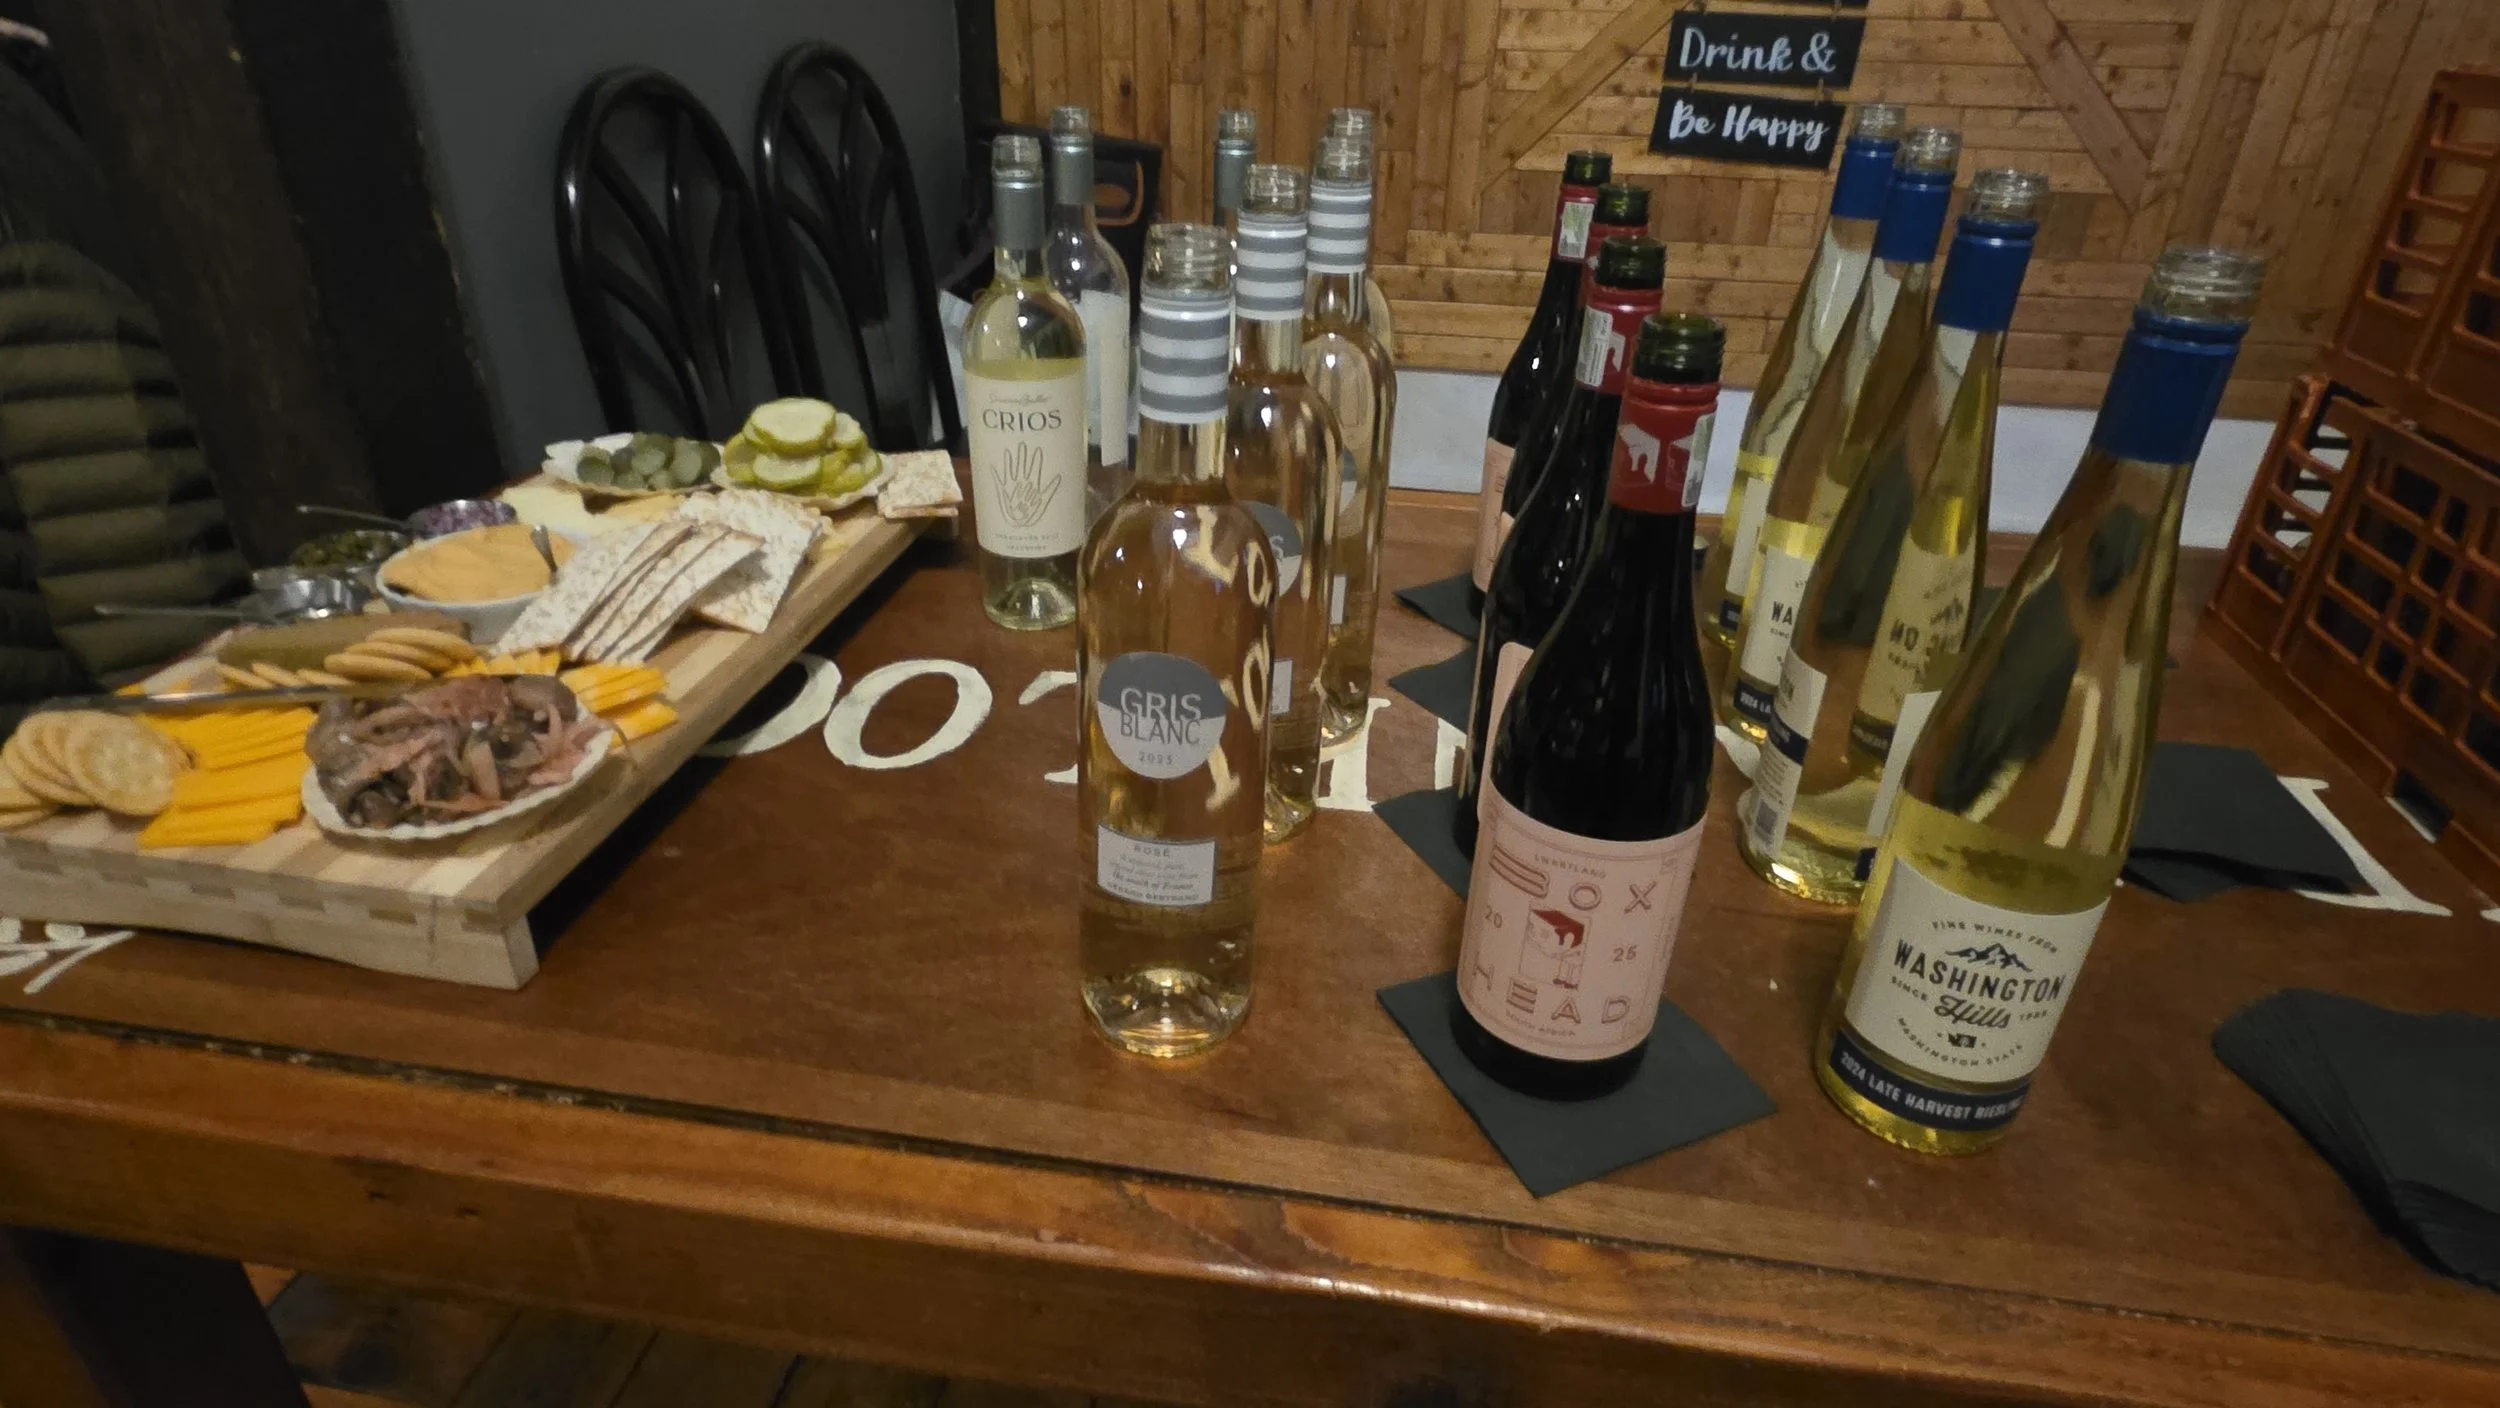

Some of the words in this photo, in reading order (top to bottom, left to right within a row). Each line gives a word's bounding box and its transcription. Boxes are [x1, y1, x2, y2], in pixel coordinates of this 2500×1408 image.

[1679, 27, 1793, 72] Drink
[1801, 33, 1836, 73] &
[1669, 100, 1715, 141] Be
[1722, 105, 1829, 151] Happy
[983, 409, 1062, 431] CRIOS
[1120, 687, 1202, 721] GRIS
[1120, 712, 1201, 745] BLANC
[1484, 904, 1503, 928] 20
[1612, 945, 1637, 963] 25
[1974, 923, 2023, 940] WINES
[1893, 939, 2067, 1003] WASHINGTON
[1890, 975, 1928, 1003] SINCE
[1934, 994, 2012, 1029] Hills
[1897, 1017, 1980, 1067] WASHINGTON
[1987, 1043, 2024, 1066] STATE
[1840, 1051, 1867, 1081] 2024
[1868, 1073, 1902, 1101] LATE
[1904, 1093, 1972, 1120] HARVEST
